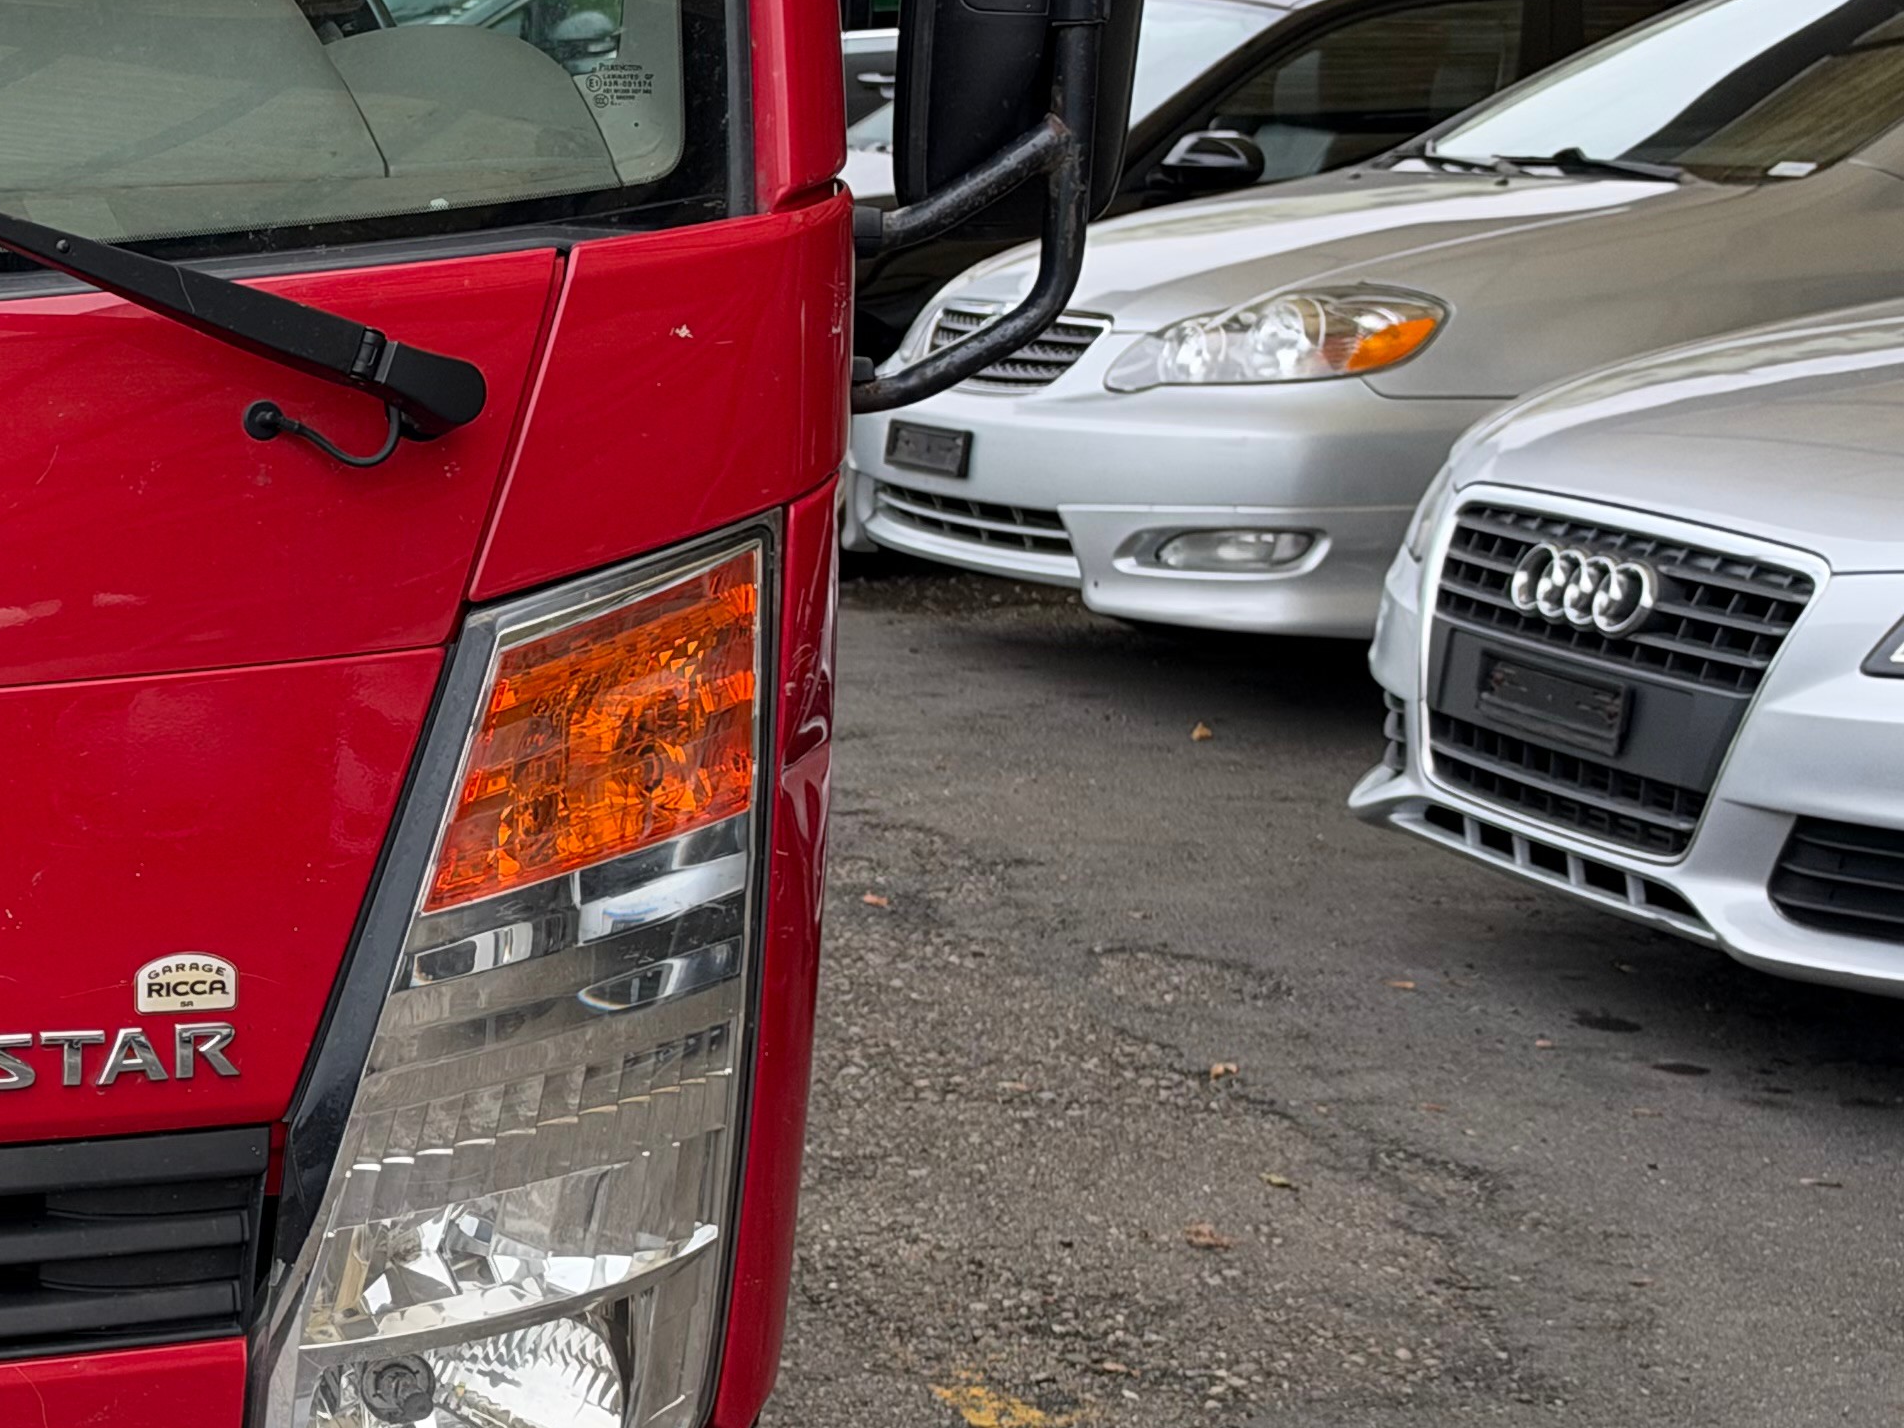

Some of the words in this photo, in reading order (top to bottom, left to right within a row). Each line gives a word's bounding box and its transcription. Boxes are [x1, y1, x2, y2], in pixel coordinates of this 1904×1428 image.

[147, 962, 227, 980] GARAGE
[147, 979, 230, 998] RICCA
[180, 1000, 194, 1008] SA
